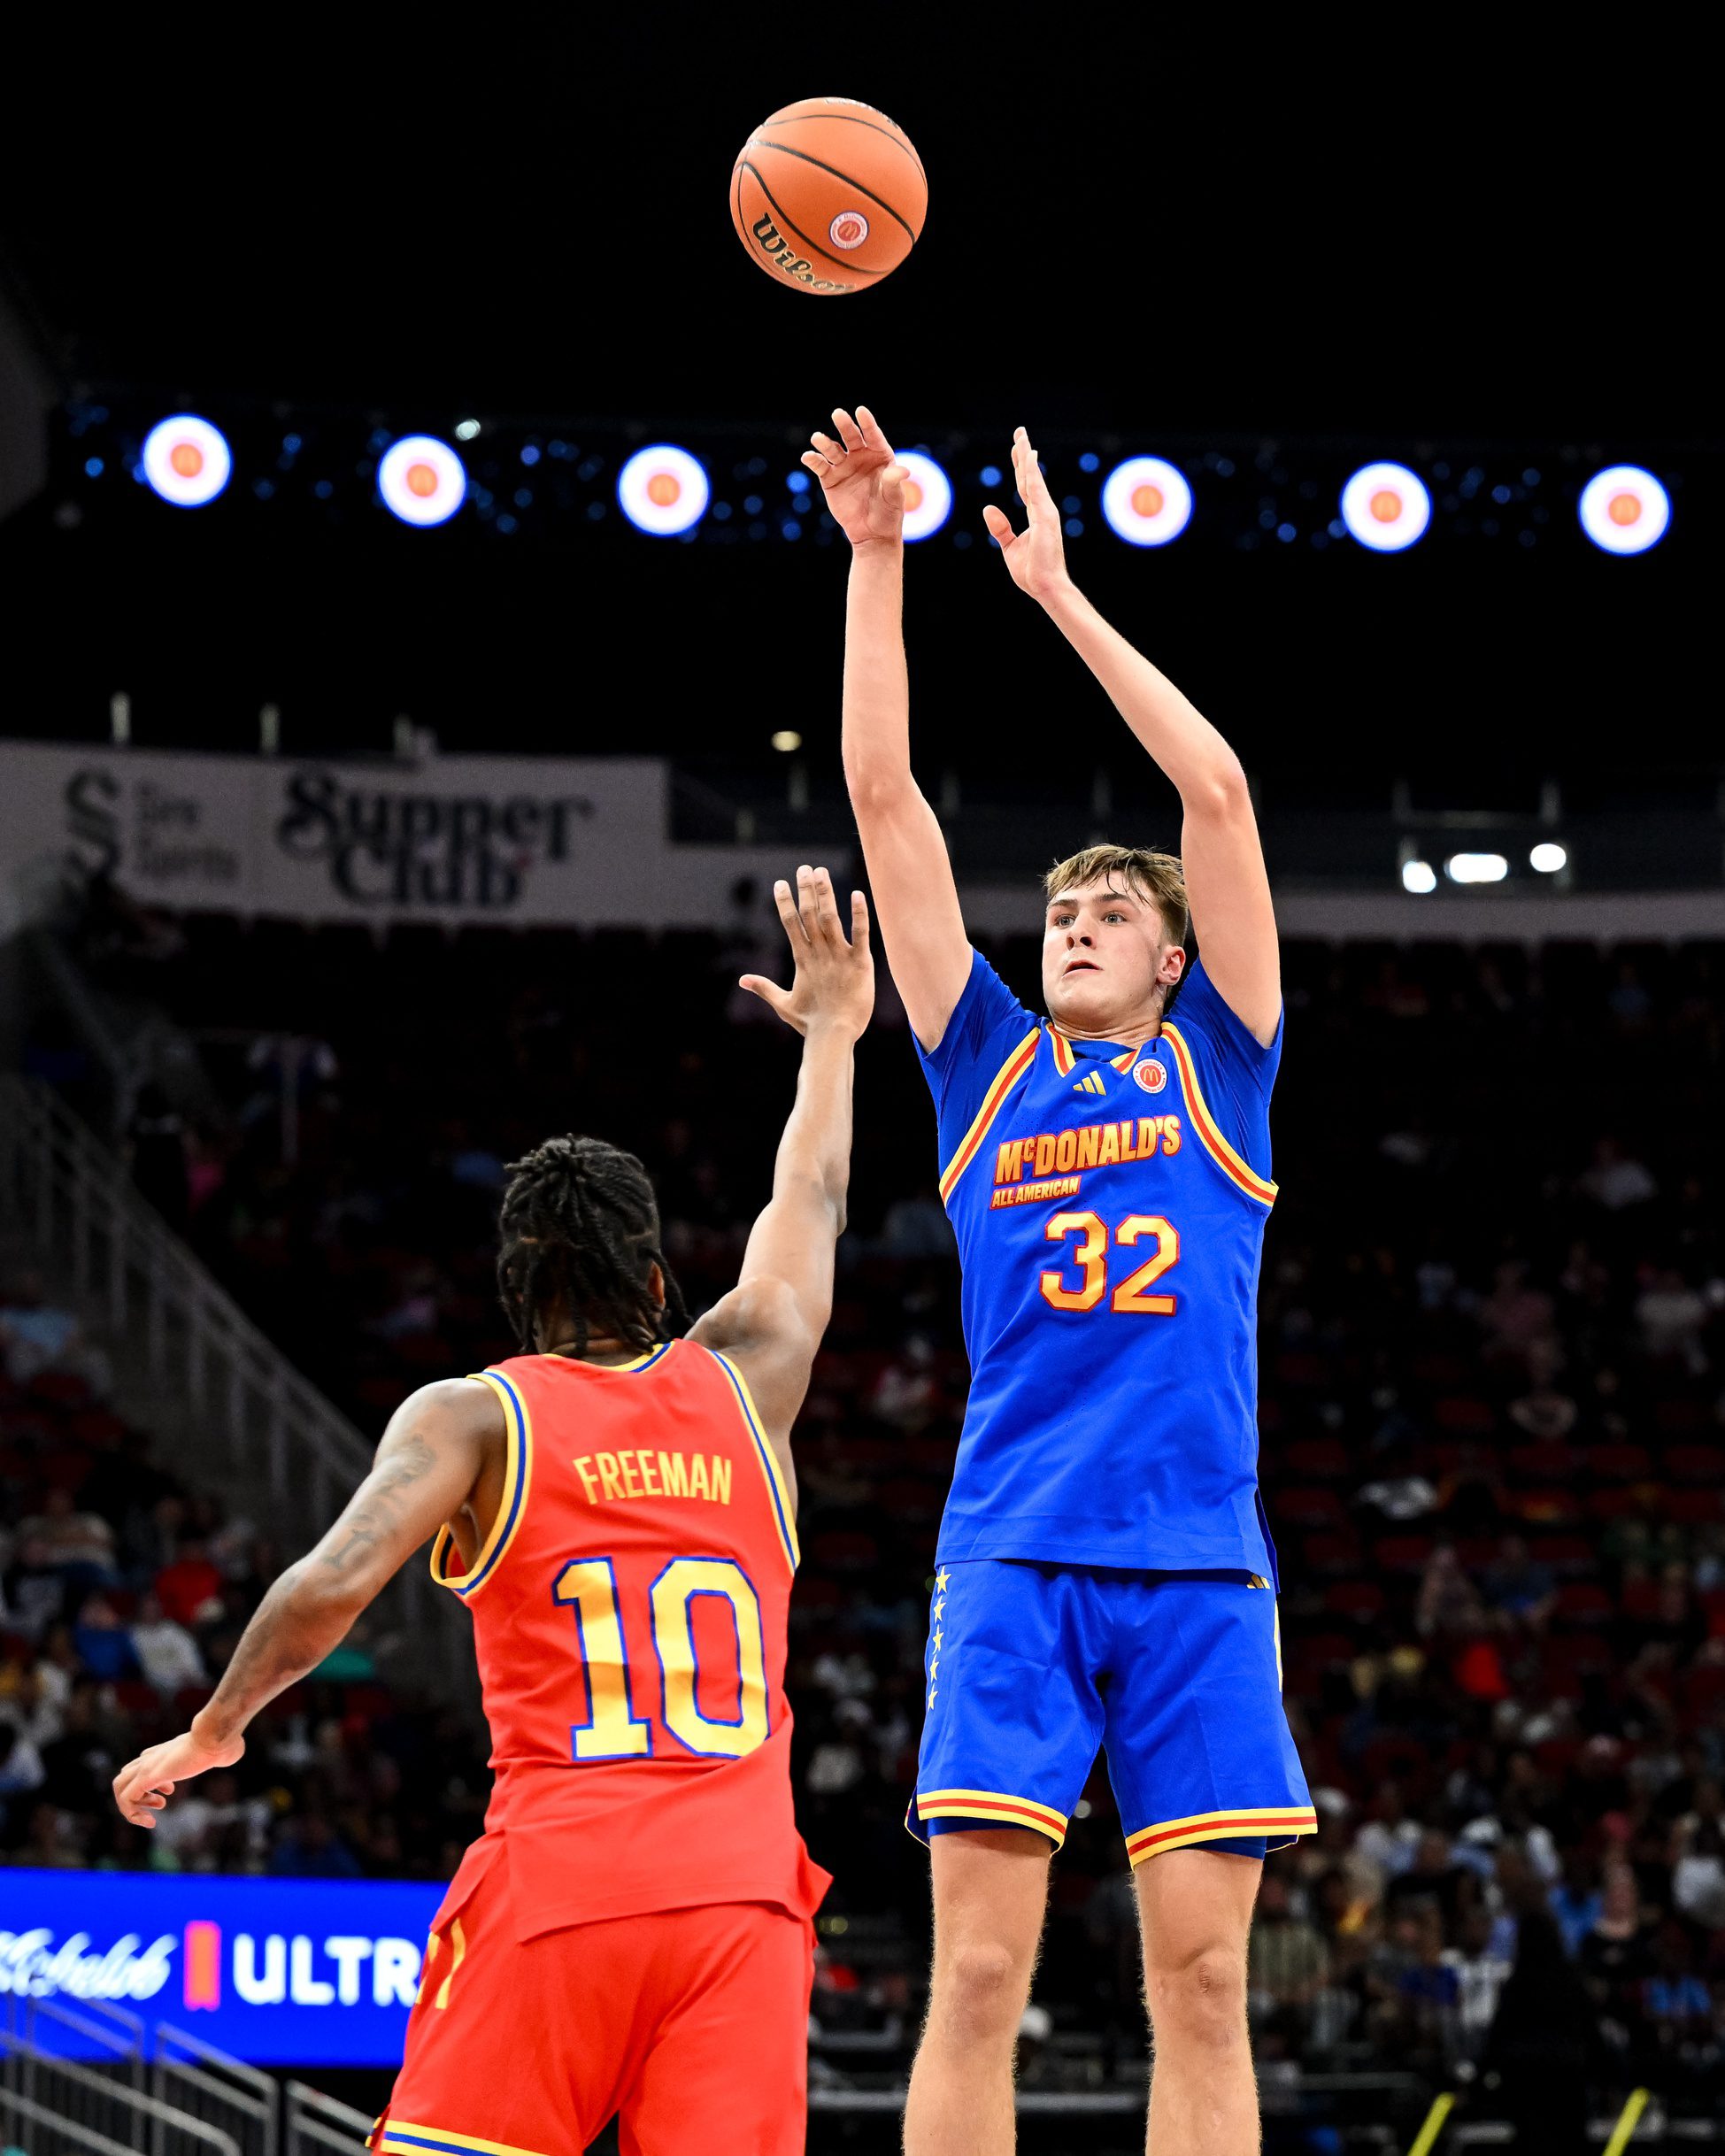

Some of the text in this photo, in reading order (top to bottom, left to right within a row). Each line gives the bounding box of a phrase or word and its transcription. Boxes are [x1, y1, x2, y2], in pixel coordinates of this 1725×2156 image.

[277, 763, 596, 865] Supper
[990, 1175, 1082, 1210] ALL AMERICAN
[1039, 1210, 1181, 1316] 32
[572, 1449, 732, 1505] FREEMAN
[551, 1555, 771, 1762] 10
[232, 1932, 422, 2007] ULTR
